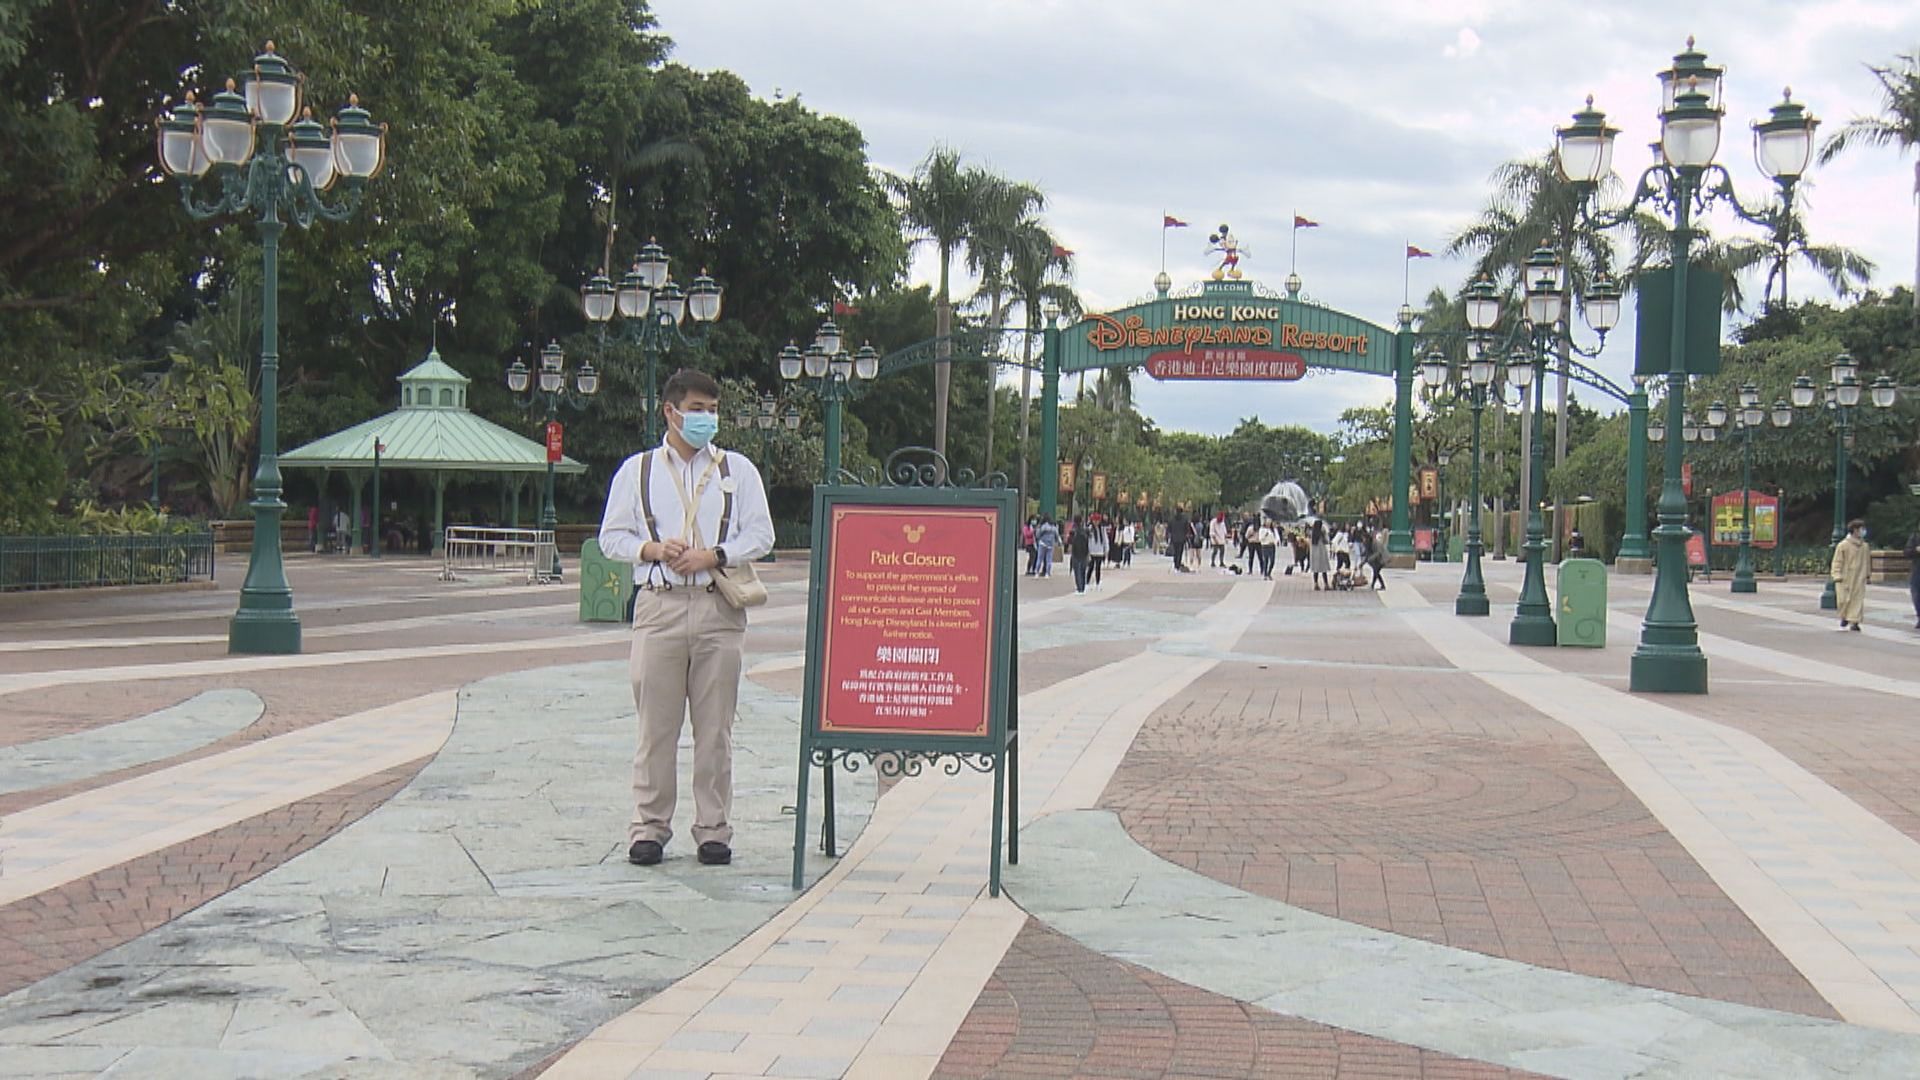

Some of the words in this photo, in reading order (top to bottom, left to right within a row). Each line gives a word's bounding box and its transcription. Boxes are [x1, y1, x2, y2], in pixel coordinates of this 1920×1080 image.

[1206, 284, 1248, 292] WELCOME
[1174, 304, 1225, 320] HONG
[1231, 305, 1279, 321] KONG
[1280, 324, 1369, 355] Resort
[870, 551, 900, 565] Park
[903, 552, 956, 567] Closure
[845, 570, 856, 579] To
[855, 571, 885, 580] support
[876, 584, 906, 593] prevent
[907, 584, 920, 592] the
[921, 585, 947, 593] spread
[872, 606, 898, 615] Guests
[915, 607, 932, 615] Cast
[840, 616, 863, 627] Hong
[864, 617, 885, 627] Kong
[886, 618, 927, 628] Disneyland
[936, 620, 960, 628] closed
[962, 621, 978, 629] until
[883, 630, 908, 638] further
[876, 646, 940, 665] 樂園關閉
